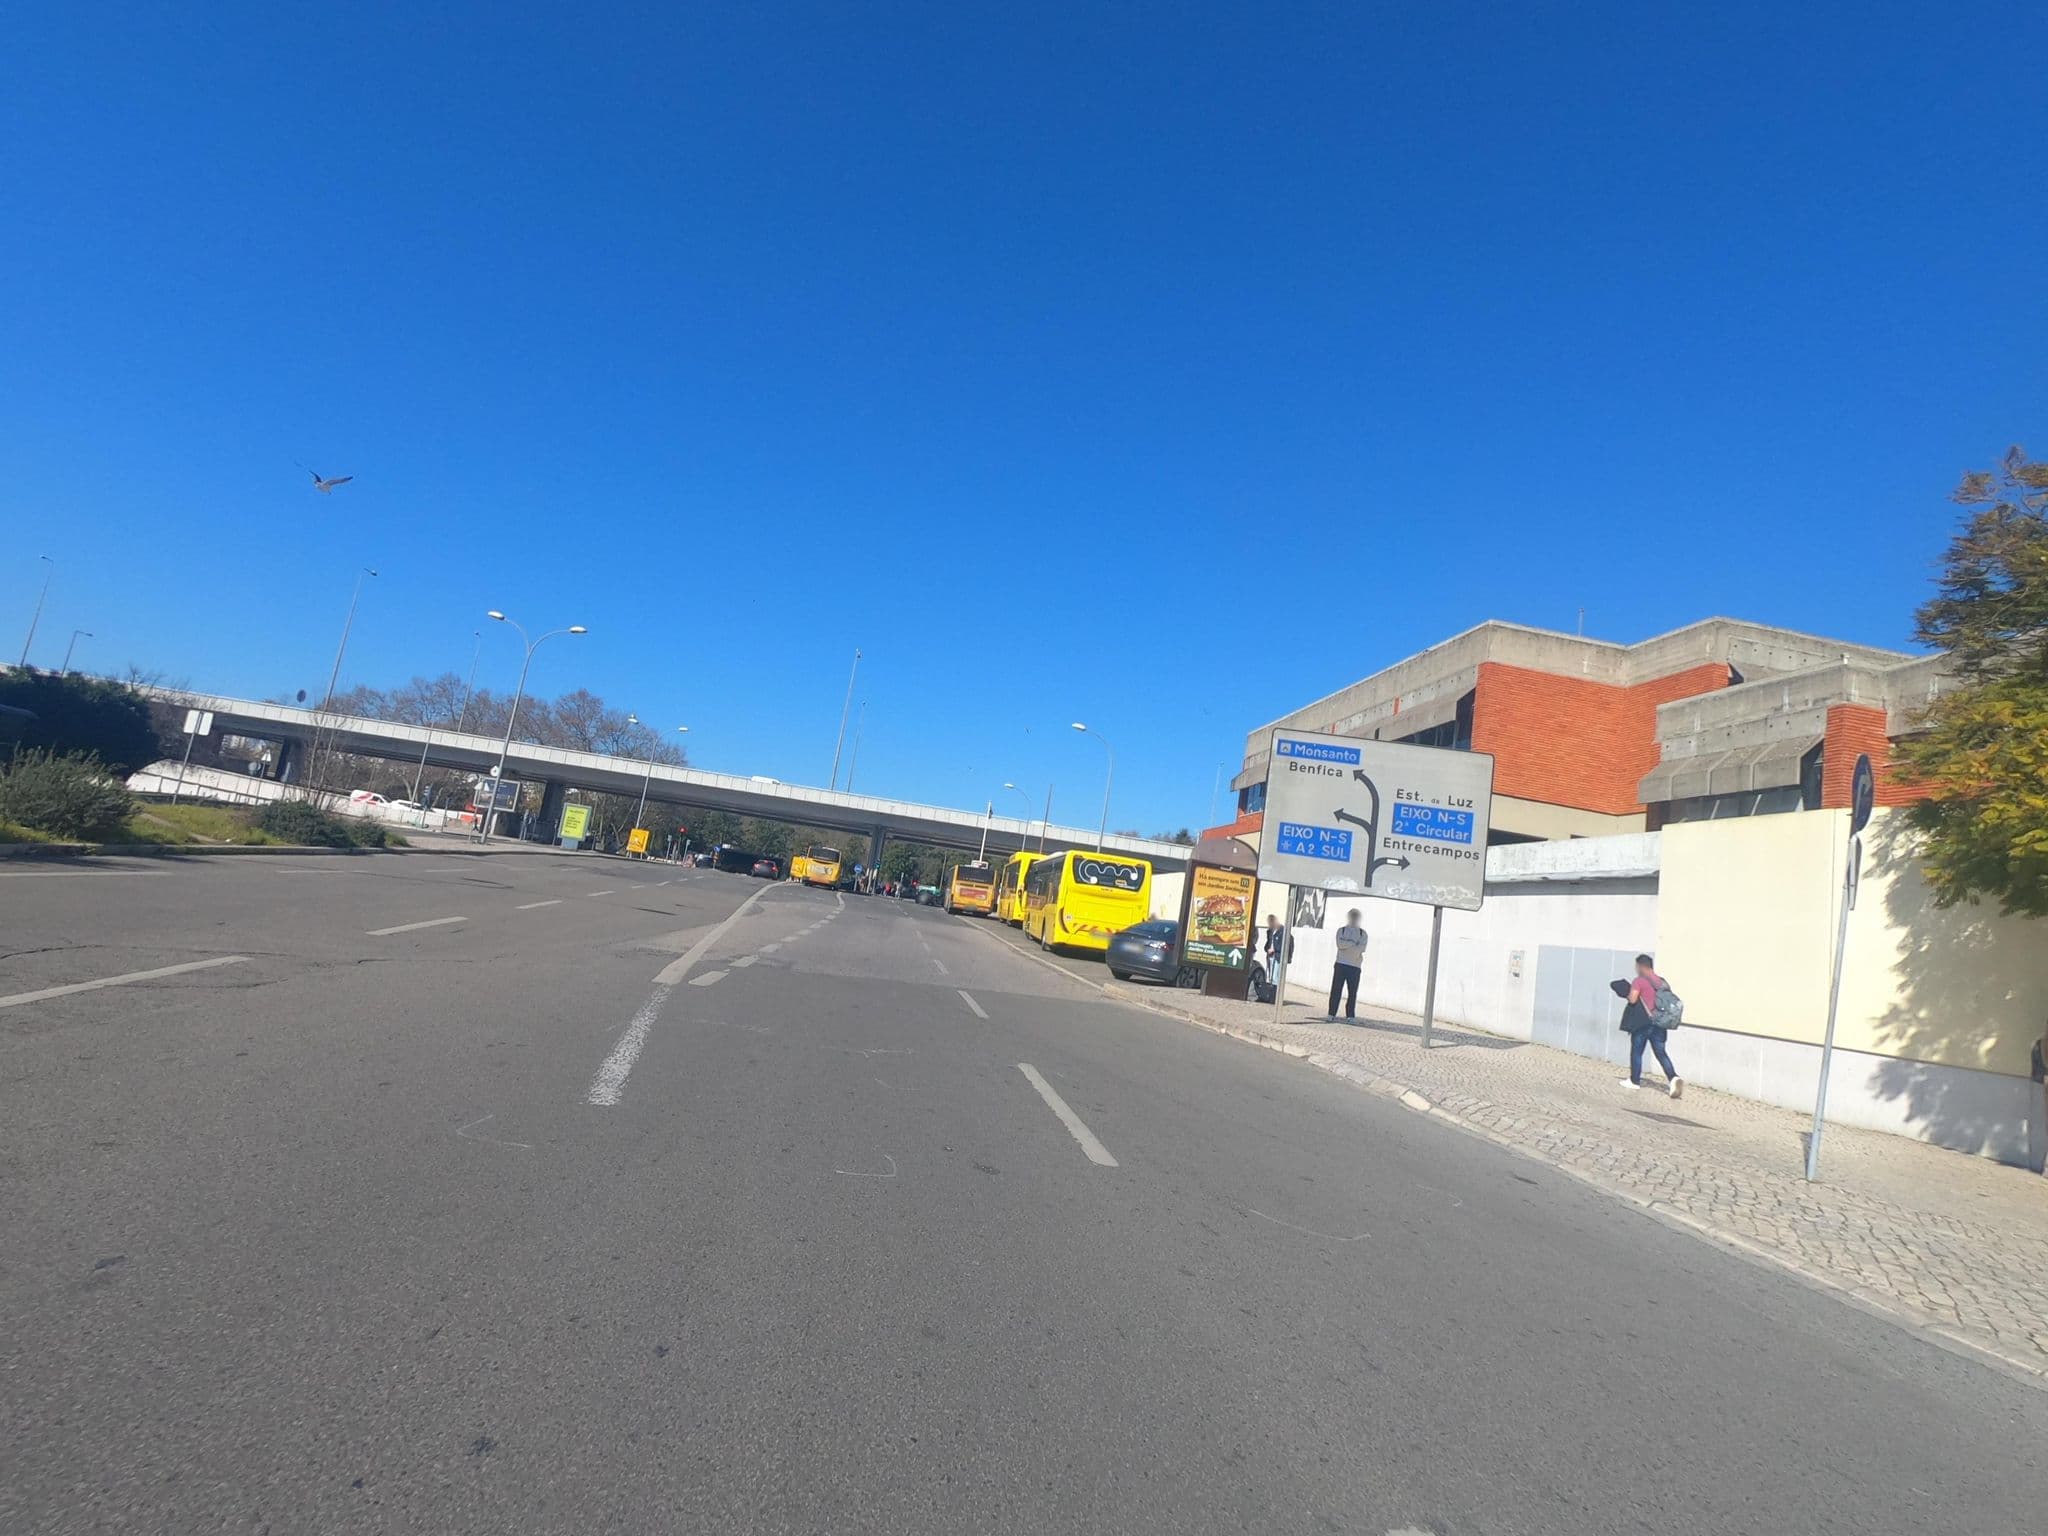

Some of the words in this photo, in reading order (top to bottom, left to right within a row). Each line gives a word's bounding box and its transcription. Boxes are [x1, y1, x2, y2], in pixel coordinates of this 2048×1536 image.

[1294, 743, 1357, 761] Monsanto
[1289, 761, 1343, 777] Benfica
[1396, 788, 1424, 802] Est.
[1447, 795, 1473, 808] Luz
[1400, 806, 1432, 820] EIXO
[1437, 811, 1466, 825] N-S
[1283, 825, 1313, 840] EIXO
[1320, 830, 1348, 844] N-S
[1415, 823, 1470, 841] Circular
[1321, 845, 1347, 859] SUL
[1383, 837, 1480, 860] Entrecampos
